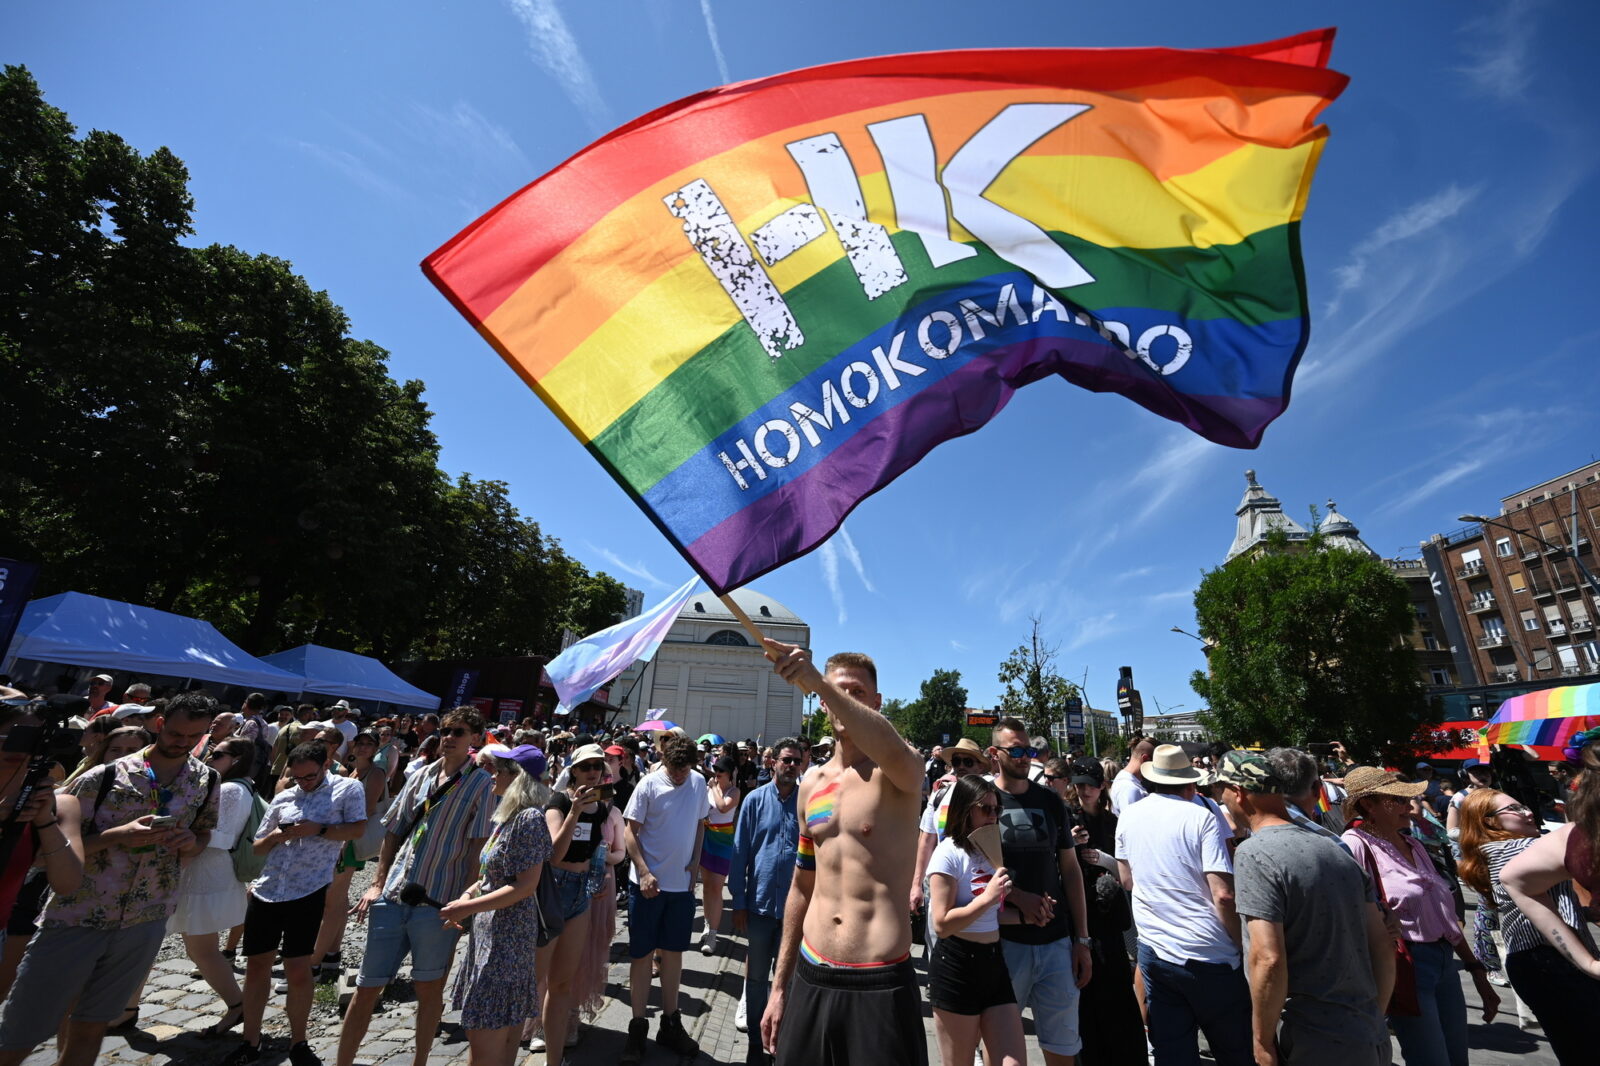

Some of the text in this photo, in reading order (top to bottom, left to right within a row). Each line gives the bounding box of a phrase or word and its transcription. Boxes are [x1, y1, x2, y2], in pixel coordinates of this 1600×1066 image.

[663, 102, 1095, 363] HK
[719, 283, 1193, 490] HOMOKOMAO
[457, 673, 470, 694] Shop
